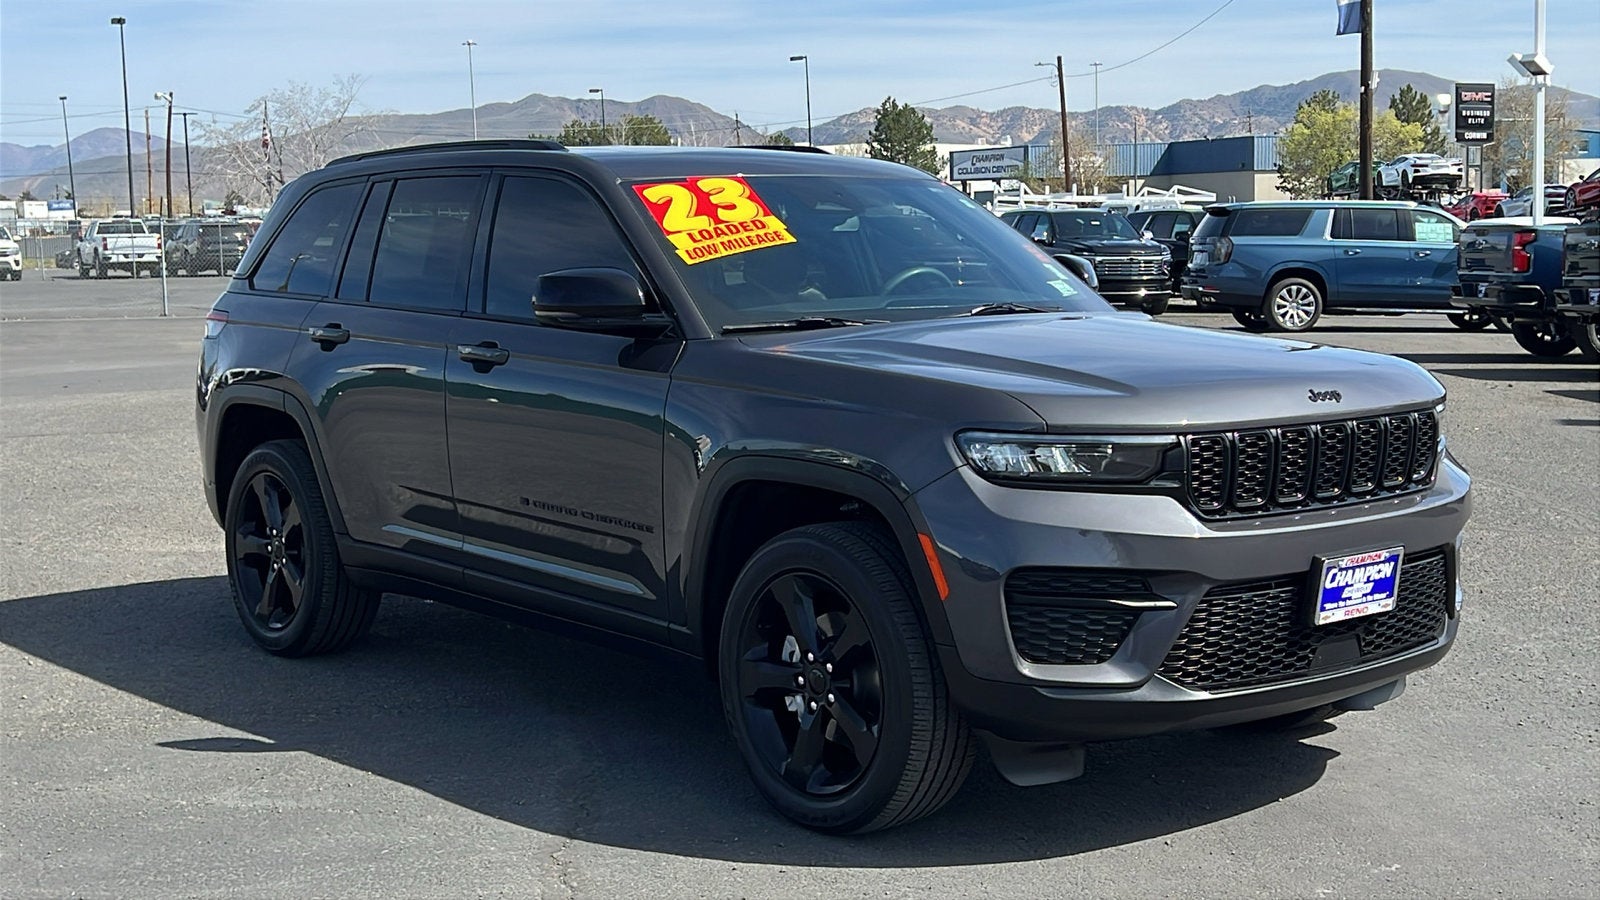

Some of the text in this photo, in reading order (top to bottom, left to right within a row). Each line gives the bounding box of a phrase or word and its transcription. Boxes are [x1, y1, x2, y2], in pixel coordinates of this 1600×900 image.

[1461, 91, 1492, 101] GMC
[971, 153, 1005, 166] CHAMPION
[957, 166, 991, 175] COLLISION
[643, 177, 764, 232] 23
[686, 219, 767, 244] LOADED
[685, 230, 785, 261] LOW MILEAGE
[1308, 388, 1342, 403] Jeep
[1346, 552, 1384, 566] CHAMPION
[1325, 562, 1394, 589] CHAMPION
[1344, 606, 1369, 617] RENO
